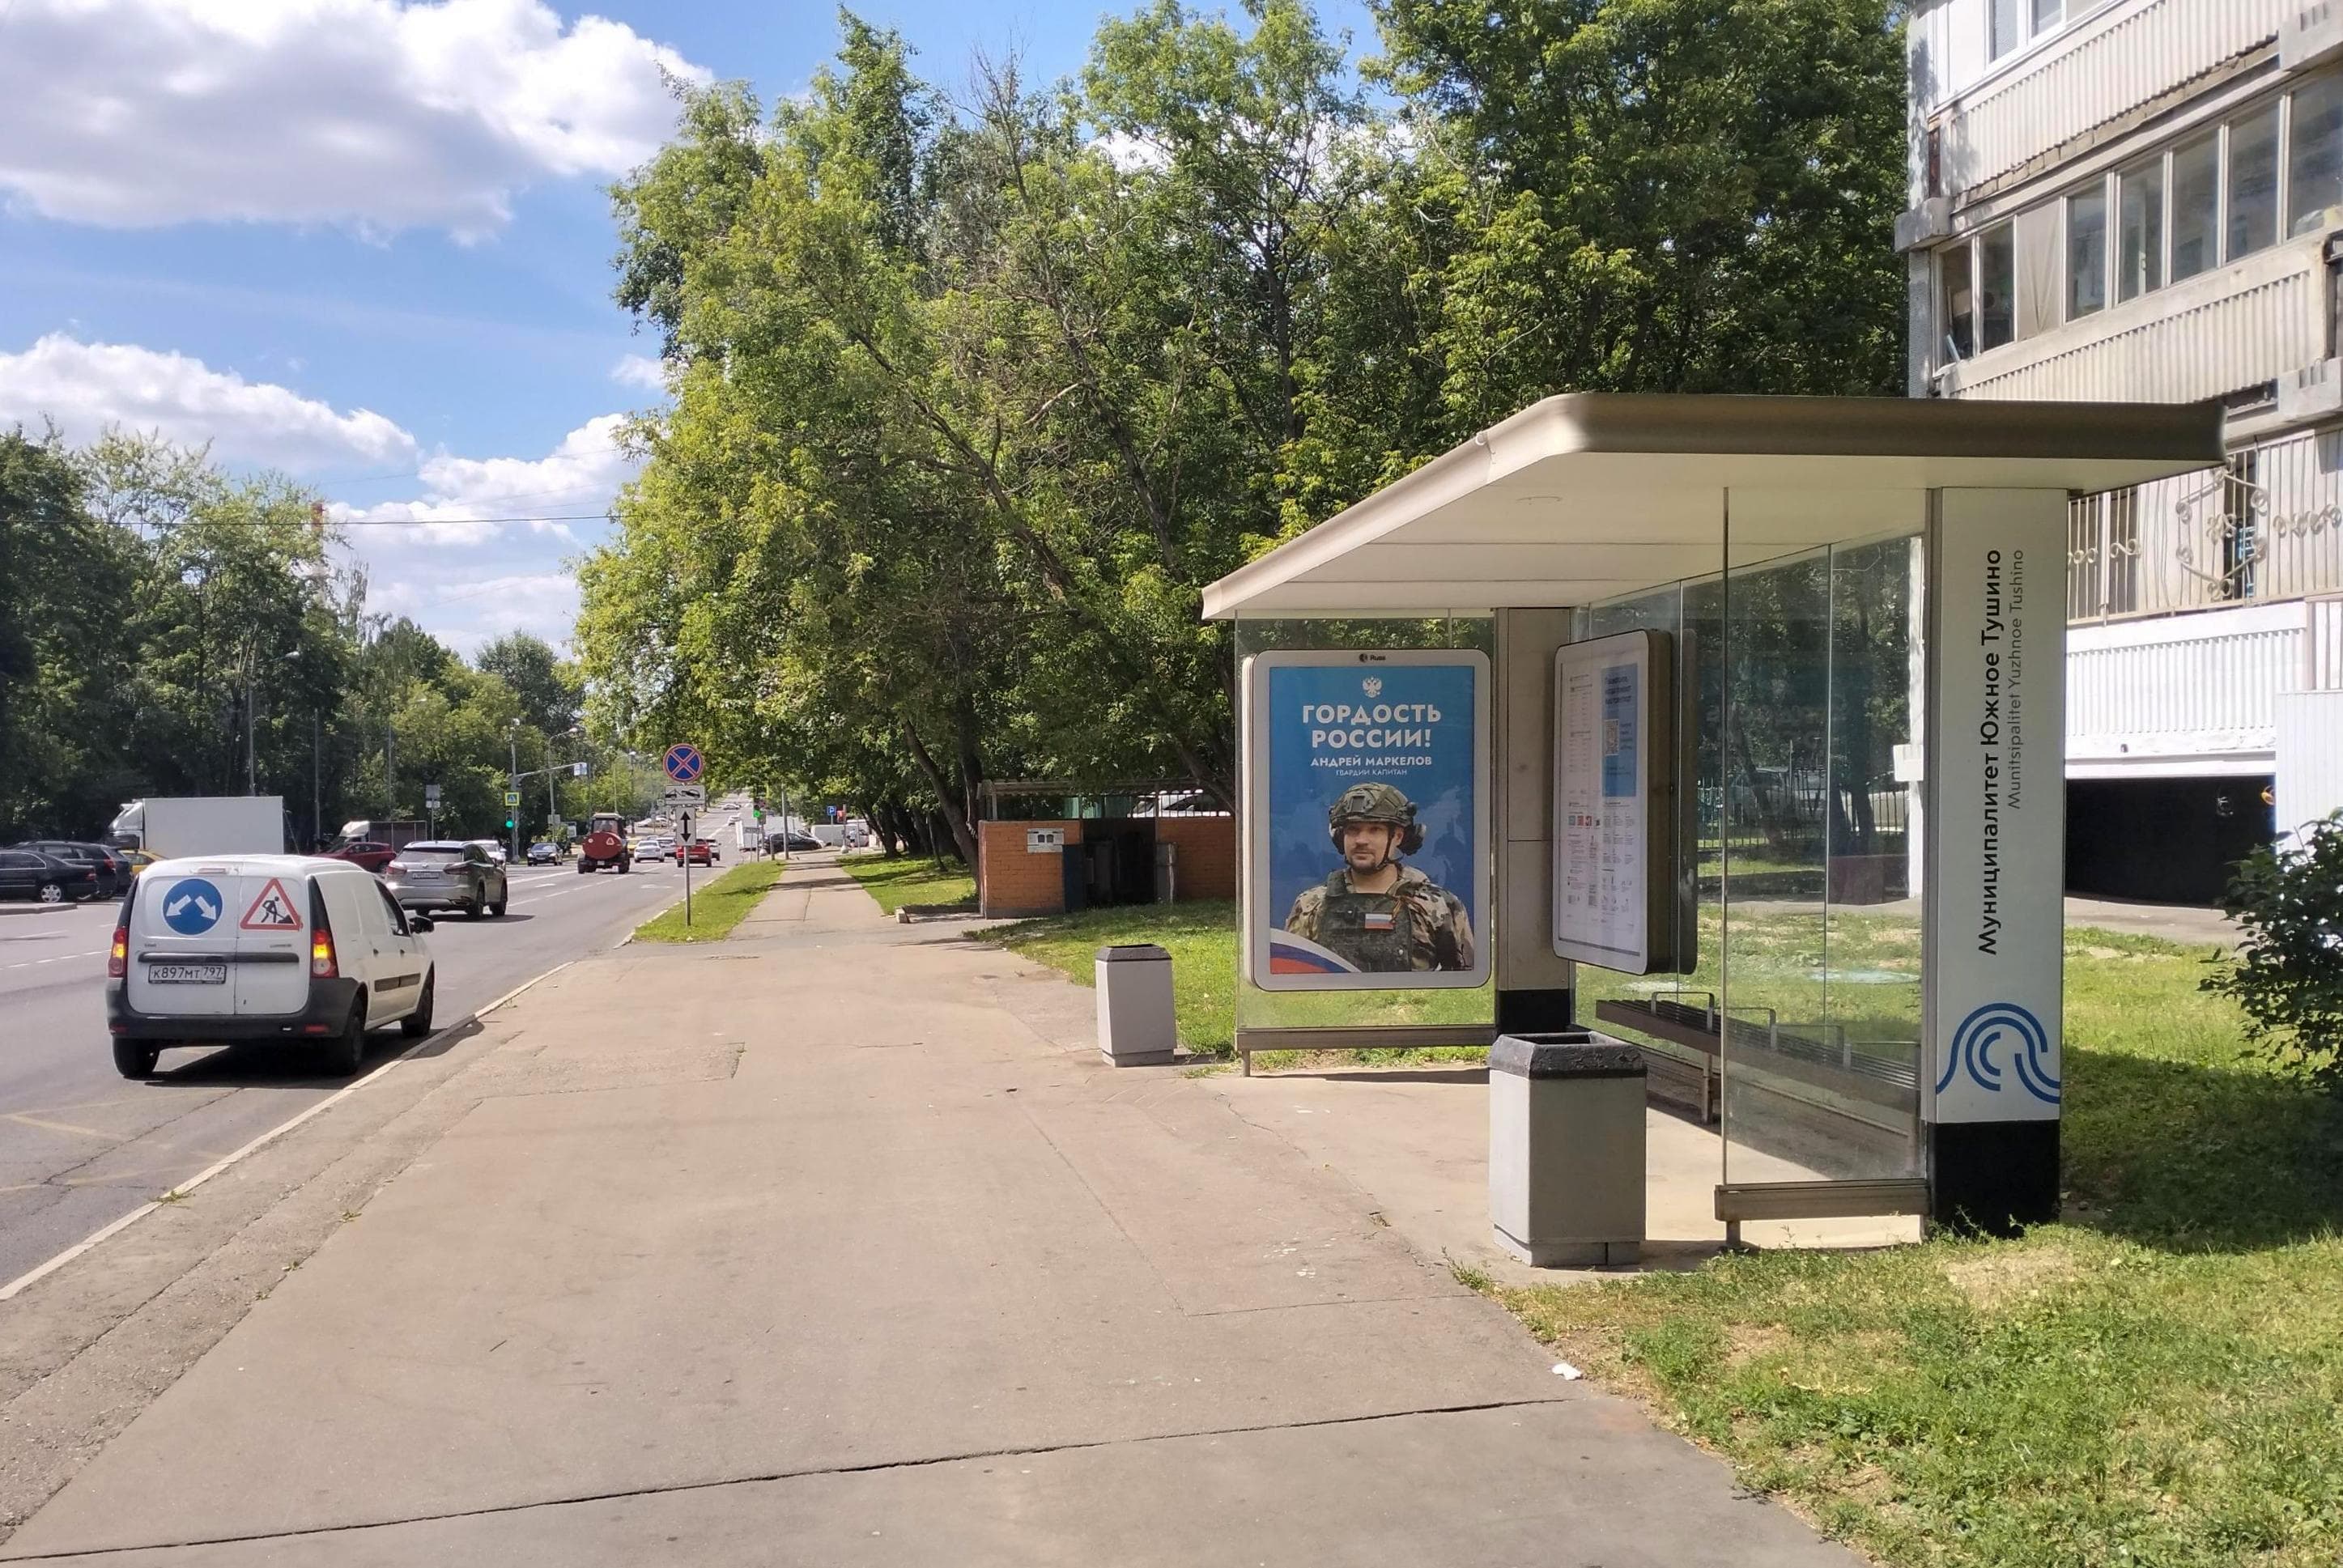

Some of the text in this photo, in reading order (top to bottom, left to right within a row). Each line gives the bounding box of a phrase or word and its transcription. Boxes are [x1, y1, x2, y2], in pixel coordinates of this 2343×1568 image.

[2007, 550, 2024, 809] Munitsipalitet Yuzhnoe Tushino
[1302, 704, 1442, 725] ГОРДОСТЬ
[1312, 729, 1431, 749] РОССИИ!
[1310, 754, 1432, 767] АНДРЕЙ МАРКЕЛОВ
[1978, 550, 2004, 956] Муниципалитет Южное Тушино
[203, 967, 223, 977] 797
